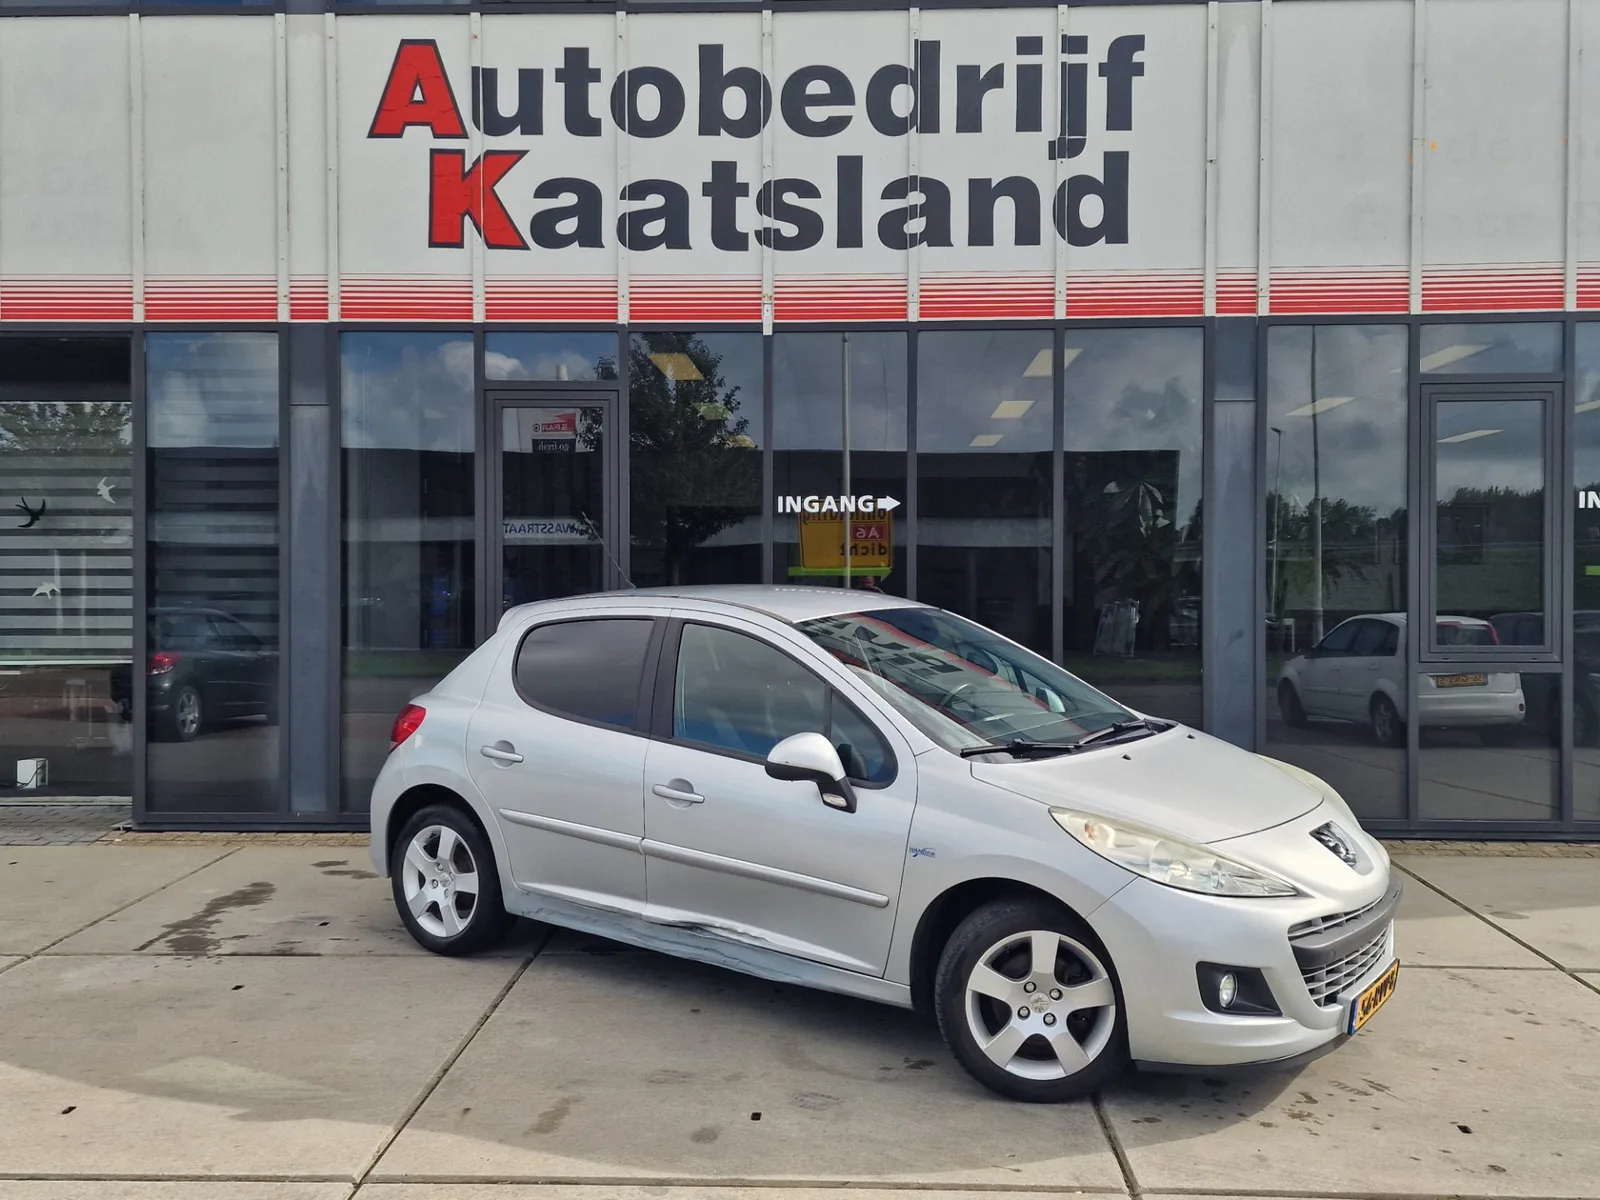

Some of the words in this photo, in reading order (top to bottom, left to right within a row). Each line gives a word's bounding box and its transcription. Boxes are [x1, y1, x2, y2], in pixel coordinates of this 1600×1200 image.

[367, 35, 1145, 161] Autobedrijf
[428, 149, 1129, 253] Kaatsland
[777, 495, 874, 513] INGANG
